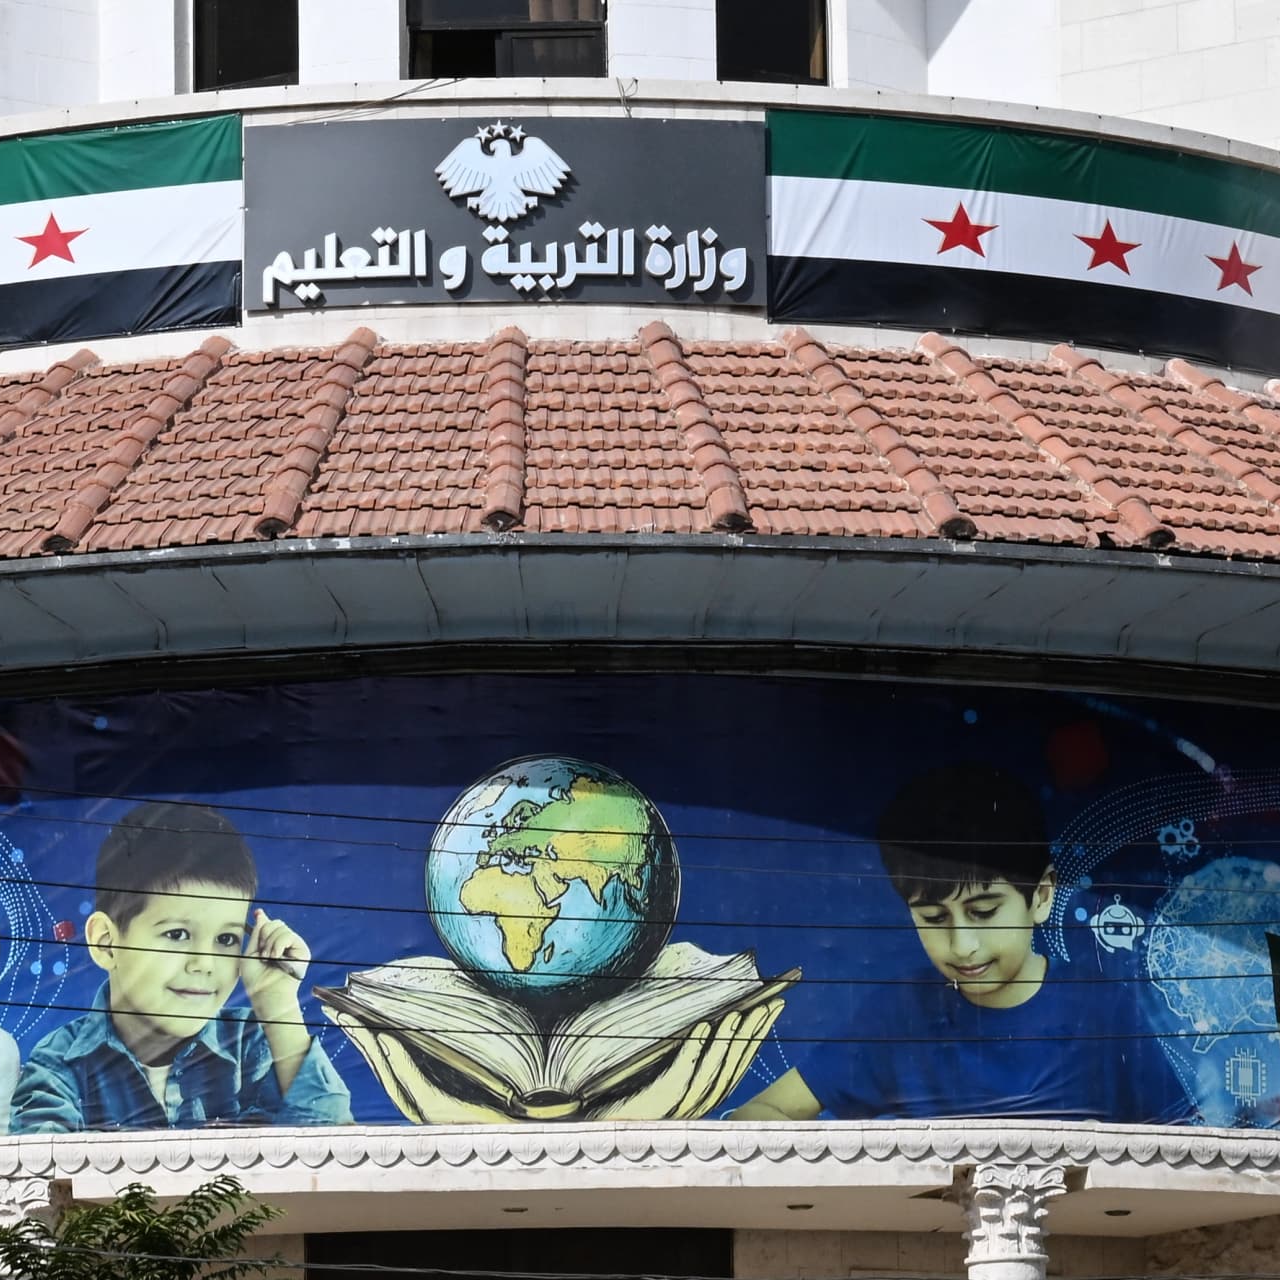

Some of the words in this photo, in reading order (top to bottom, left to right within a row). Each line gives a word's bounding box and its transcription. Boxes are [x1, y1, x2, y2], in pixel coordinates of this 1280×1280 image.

[262, 226, 427, 304] التعليم
[438, 245, 468, 291] و
[480, 221, 635, 293] التربية
[644, 224, 748, 293] وزارة
